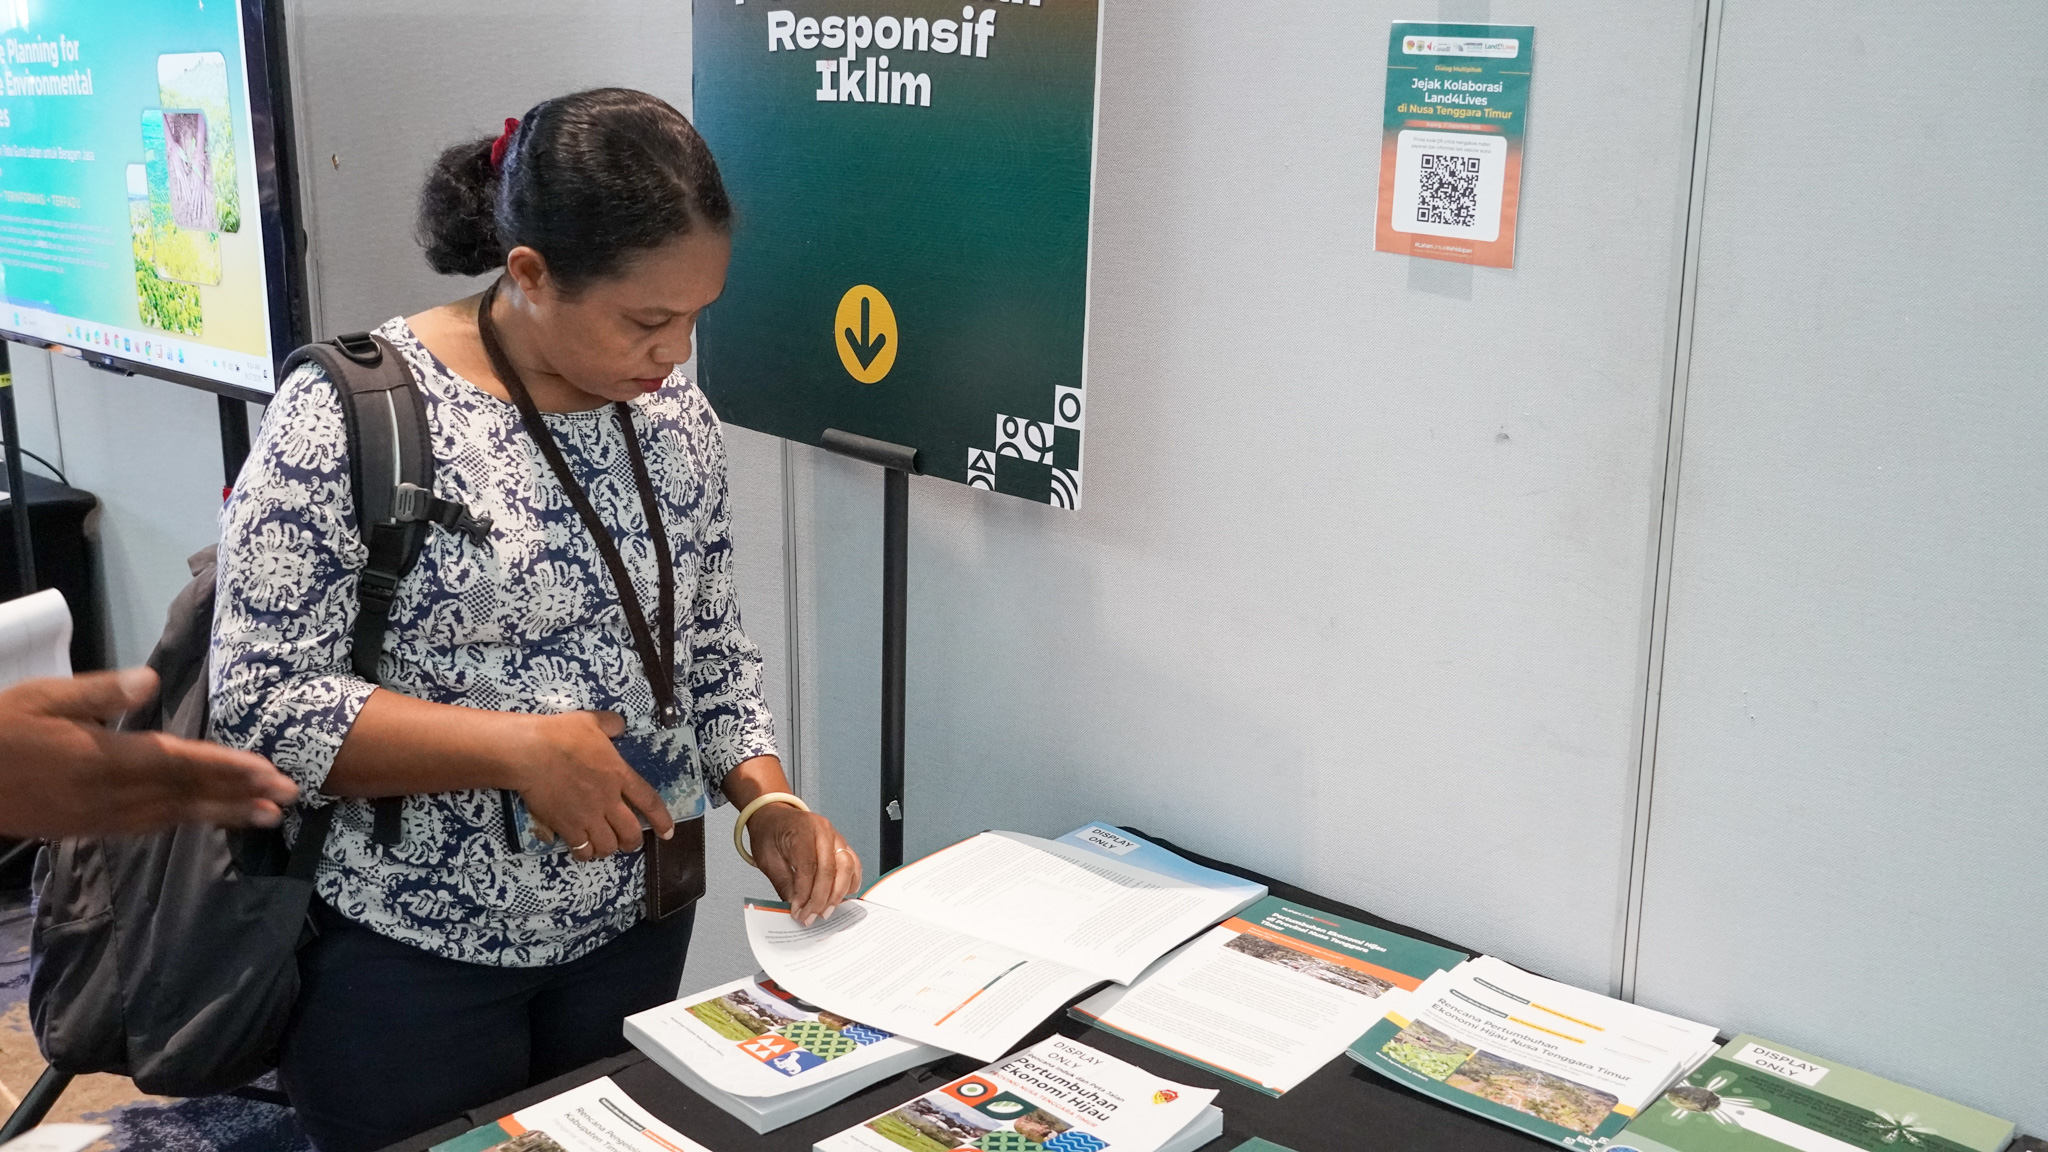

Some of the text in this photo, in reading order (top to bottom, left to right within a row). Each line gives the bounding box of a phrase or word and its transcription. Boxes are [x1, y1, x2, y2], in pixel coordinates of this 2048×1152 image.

[767, 5, 996, 60] Responsif
[6, 34, 59, 68] Planning
[60, 33, 80, 62] for
[4, 67, 94, 96] Environmental
[816, 55, 932, 107] Iklim
[1411, 78, 1503, 93] Jejak Kolaborasi
[1397, 103, 1513, 119] di Nusa Tenggara Timur
[1424, 92, 1488, 105] Land4Lives
[1089, 836, 1117, 849] ONLY
[1092, 828, 1134, 847] DISPLAY
[1260, 919, 1285, 931] Timur
[1271, 912, 1327, 934] Pertumbuhan
[1327, 930, 1366, 945] Ekonomi
[1363, 941, 1387, 953] Hijau
[1275, 919, 1309, 933] Provinsi
[1308, 930, 1329, 940] Nusa
[1330, 937, 1369, 953] Tenggara
[1438, 998, 1482, 1023] Rencana
[1483, 1020, 1559, 1051] Pertumbuhan
[1053, 1041, 1104, 1066] DISPLAY
[1431, 1003, 1480, 1030] Ekonomi
[1480, 1027, 1508, 1041] Hijau
[1510, 1038, 1538, 1052] Nusa
[1542, 1048, 1594, 1070] Tenggara
[1597, 1066, 1632, 1081] Timur
[1048, 1052, 1081, 1069] ONLY
[1753, 1047, 1819, 1072] DISPLAY
[1755, 1059, 1799, 1077] ONLY
[1000, 1063, 1110, 1122] Ekonomi Hijau
[1013, 1057, 1118, 1112] Pertumbuhan
[1027, 1053, 1125, 1103] Rencana Induk dan Peta Jalan
[988, 1070, 1098, 1127] PROVINSI NUSA TENGGARA TIMUR
[564, 1112, 603, 1143] Kabupaten
[576, 1106, 607, 1132] Rencana
